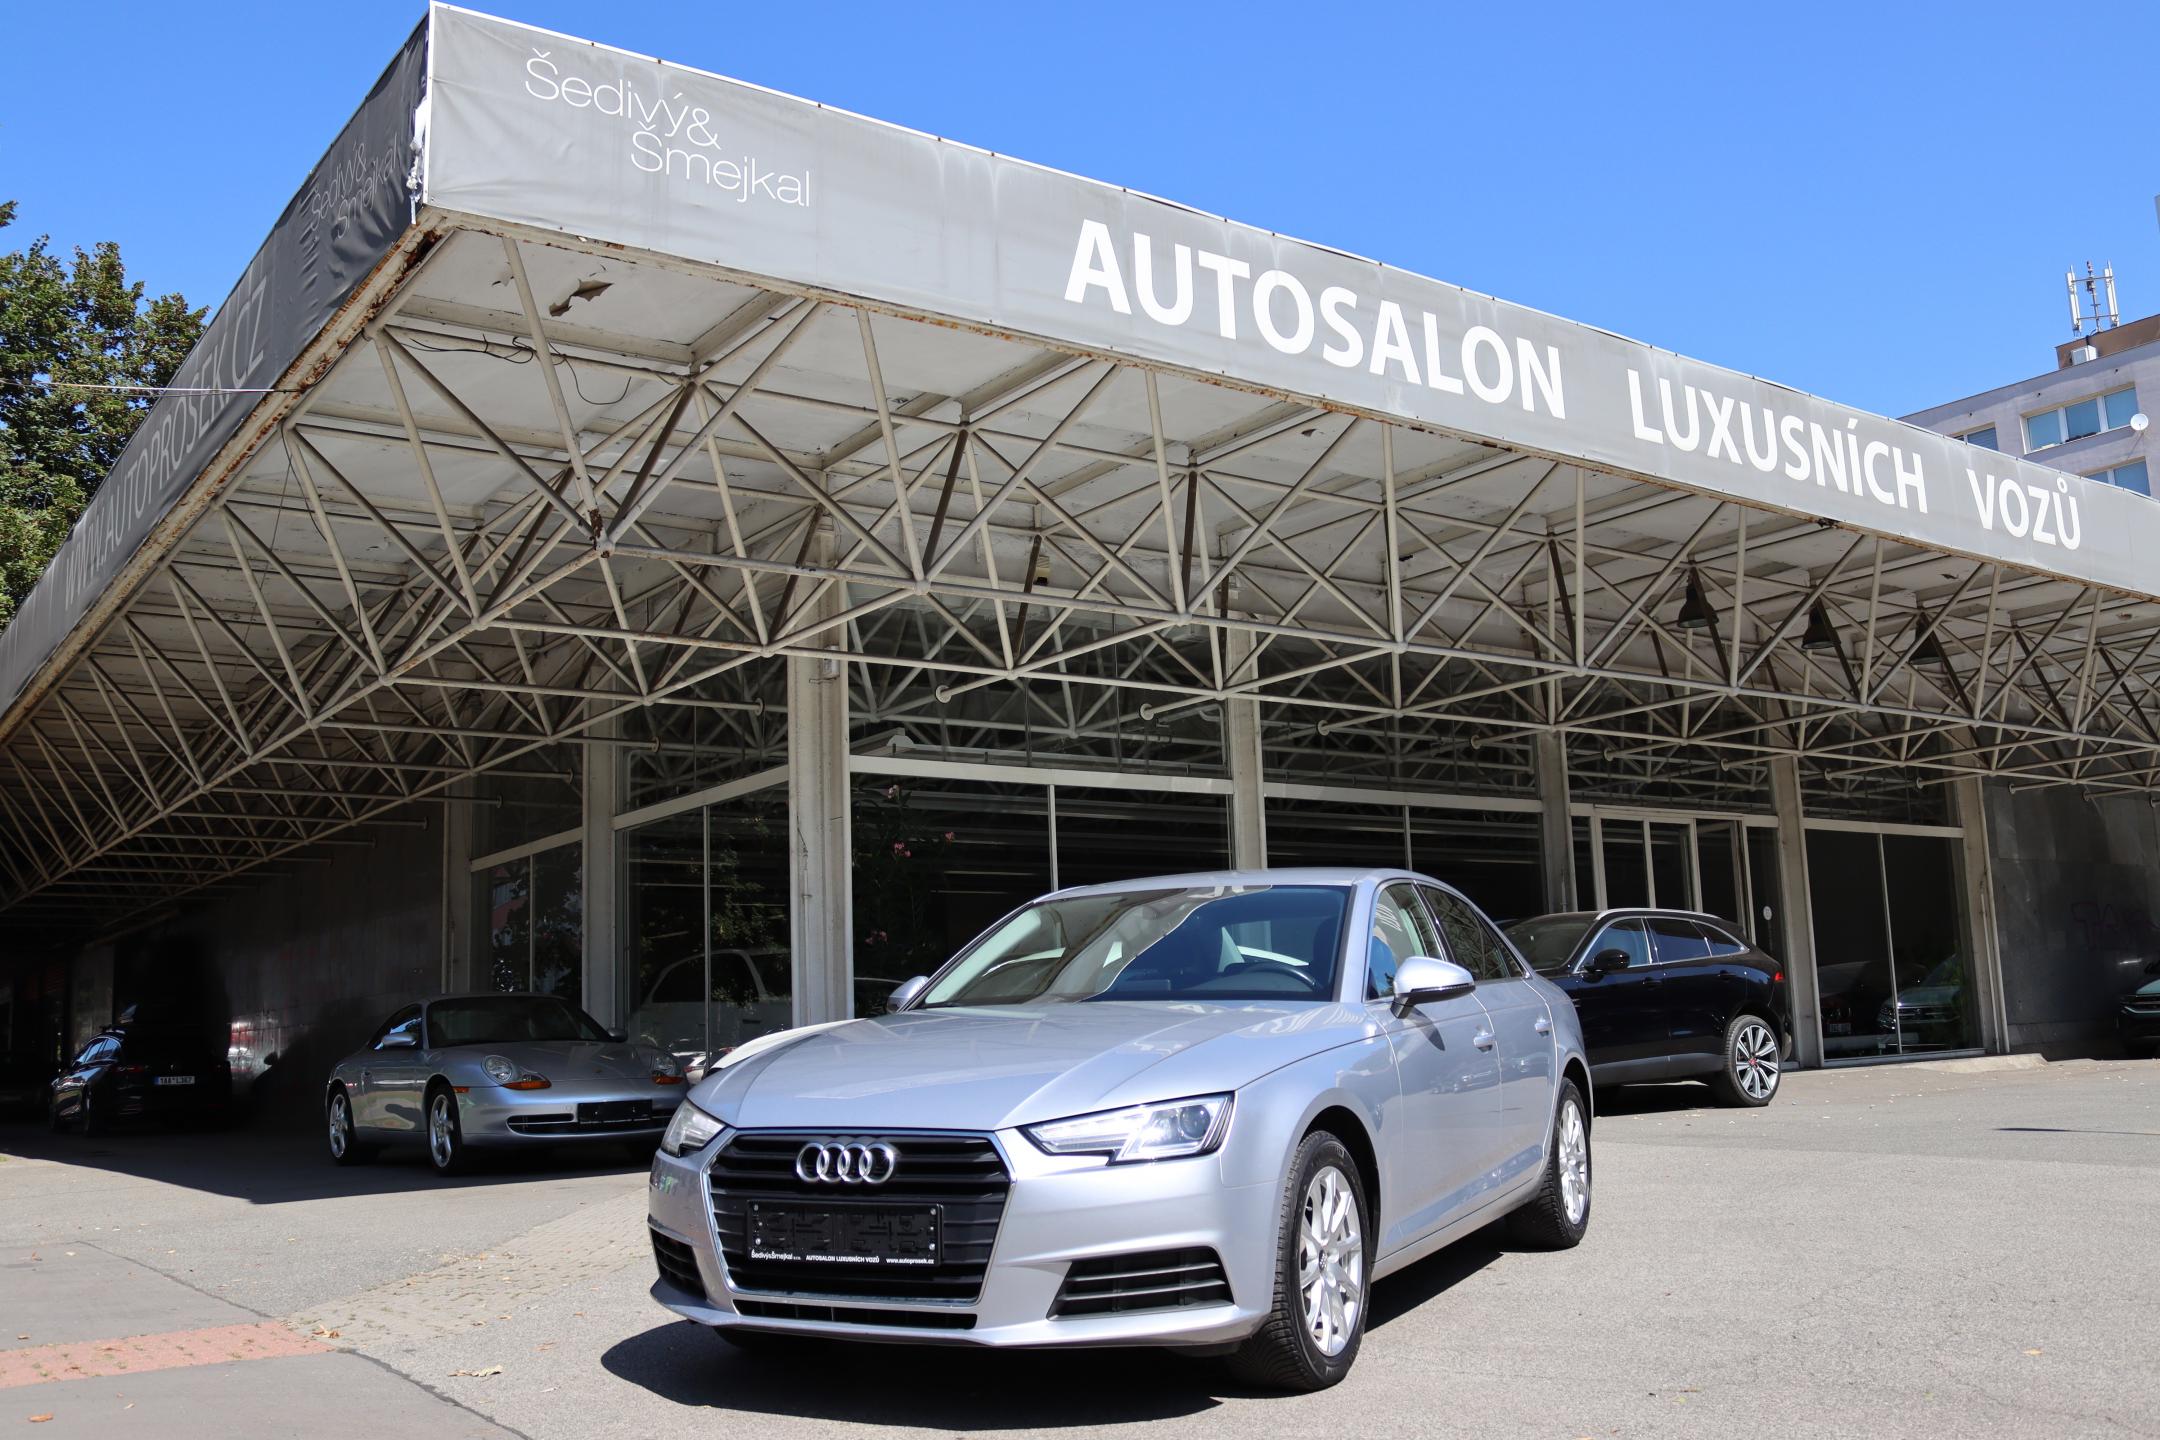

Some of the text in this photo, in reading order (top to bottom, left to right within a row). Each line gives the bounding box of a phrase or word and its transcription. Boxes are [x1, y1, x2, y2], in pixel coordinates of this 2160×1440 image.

[524, 47, 721, 150] Šedivý&
[630, 120, 811, 207] Šmejkal
[1064, 218, 2082, 551] AUTOSALON LUXUSNÍCH VOZŮ
[806, 1254, 836, 1262] AUTOSALON
